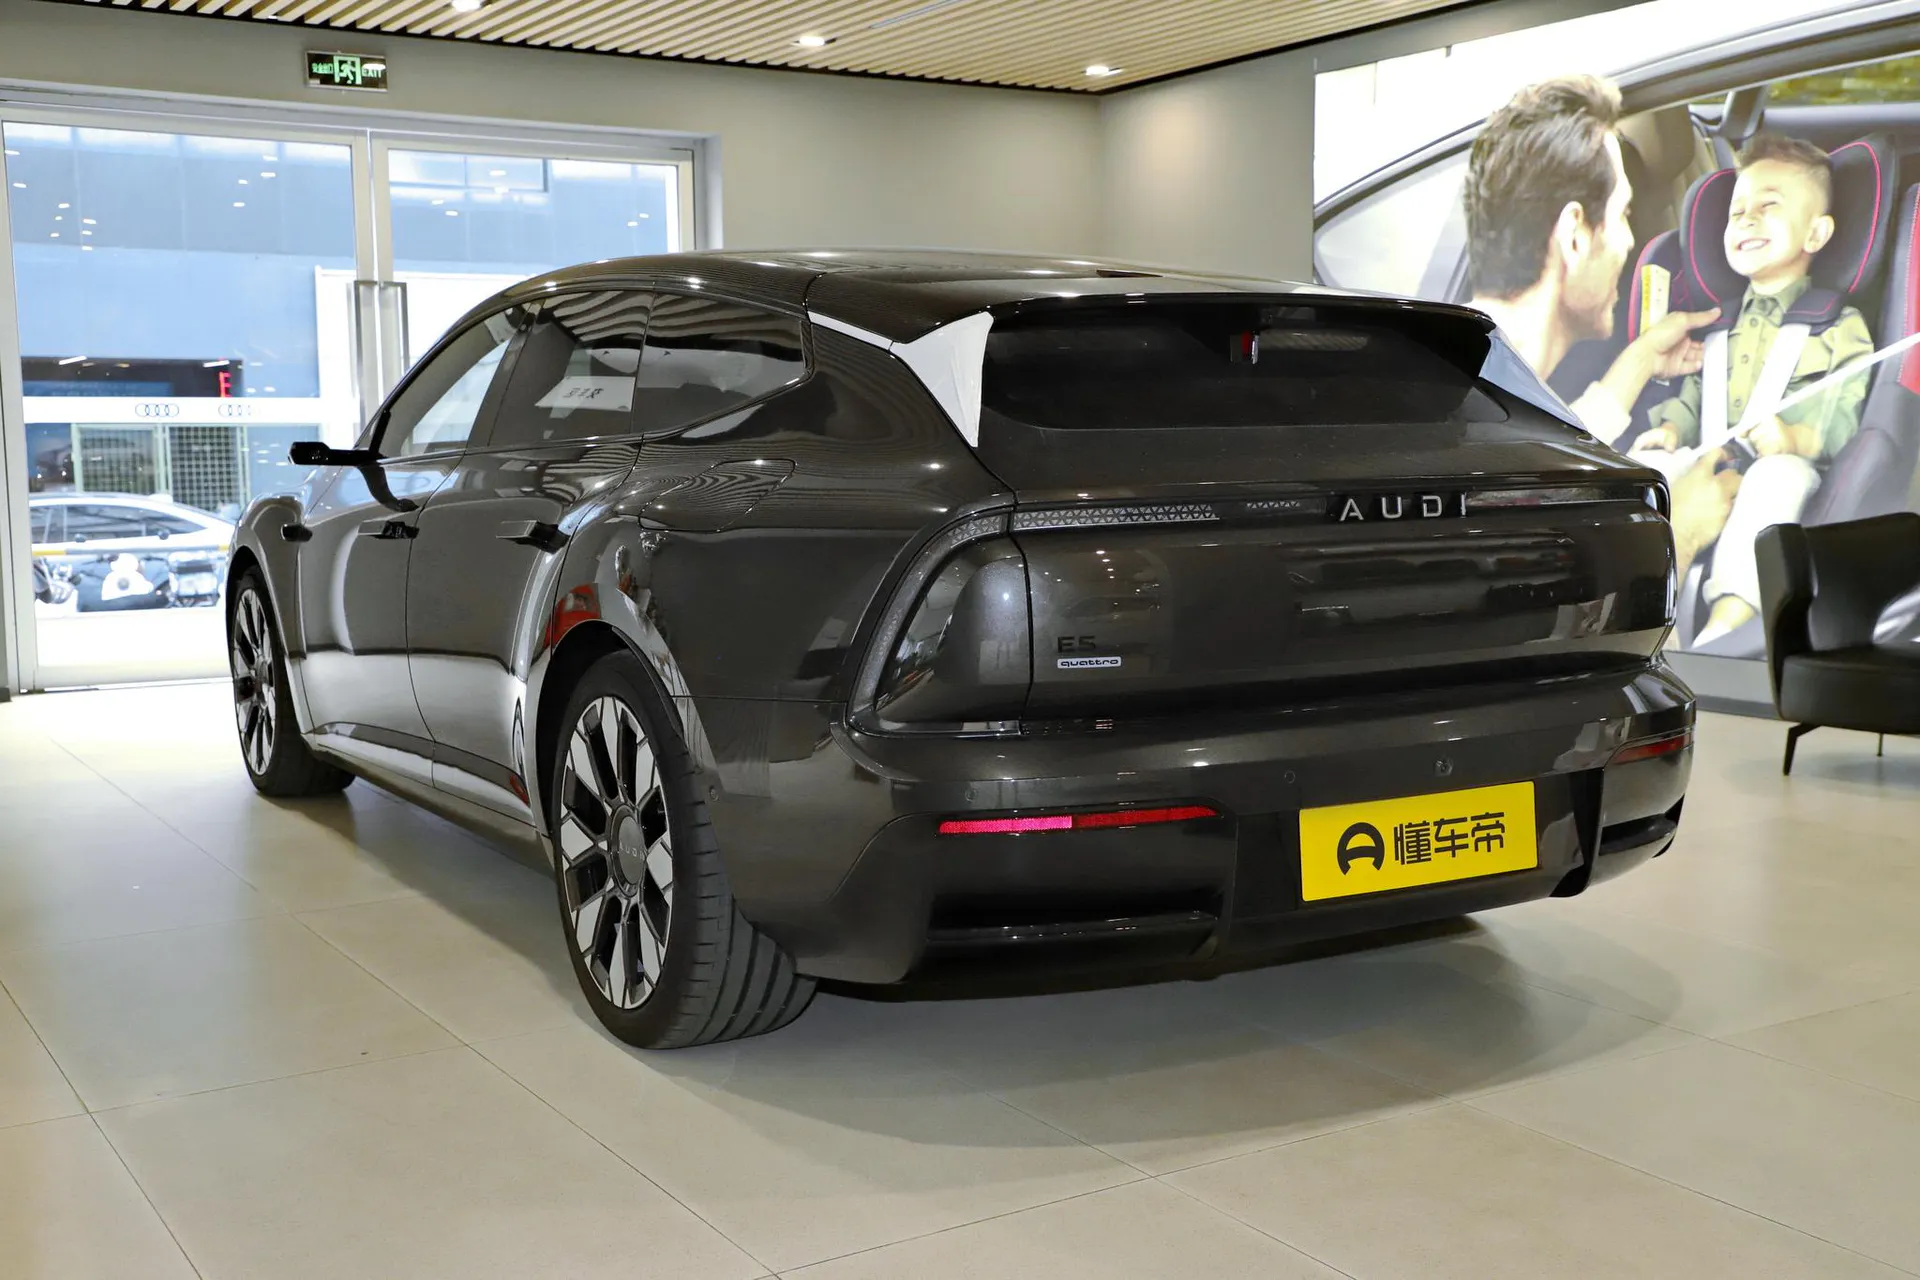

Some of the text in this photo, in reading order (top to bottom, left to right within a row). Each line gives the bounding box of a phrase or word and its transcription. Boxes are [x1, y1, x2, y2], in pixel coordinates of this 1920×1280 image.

[361, 67, 383, 78] EXIT
[1340, 493, 1466, 521] AUDI
[1057, 635, 1096, 653] E5
[1060, 658, 1119, 668] quattro
[1393, 811, 1506, 866] 懂车帝
